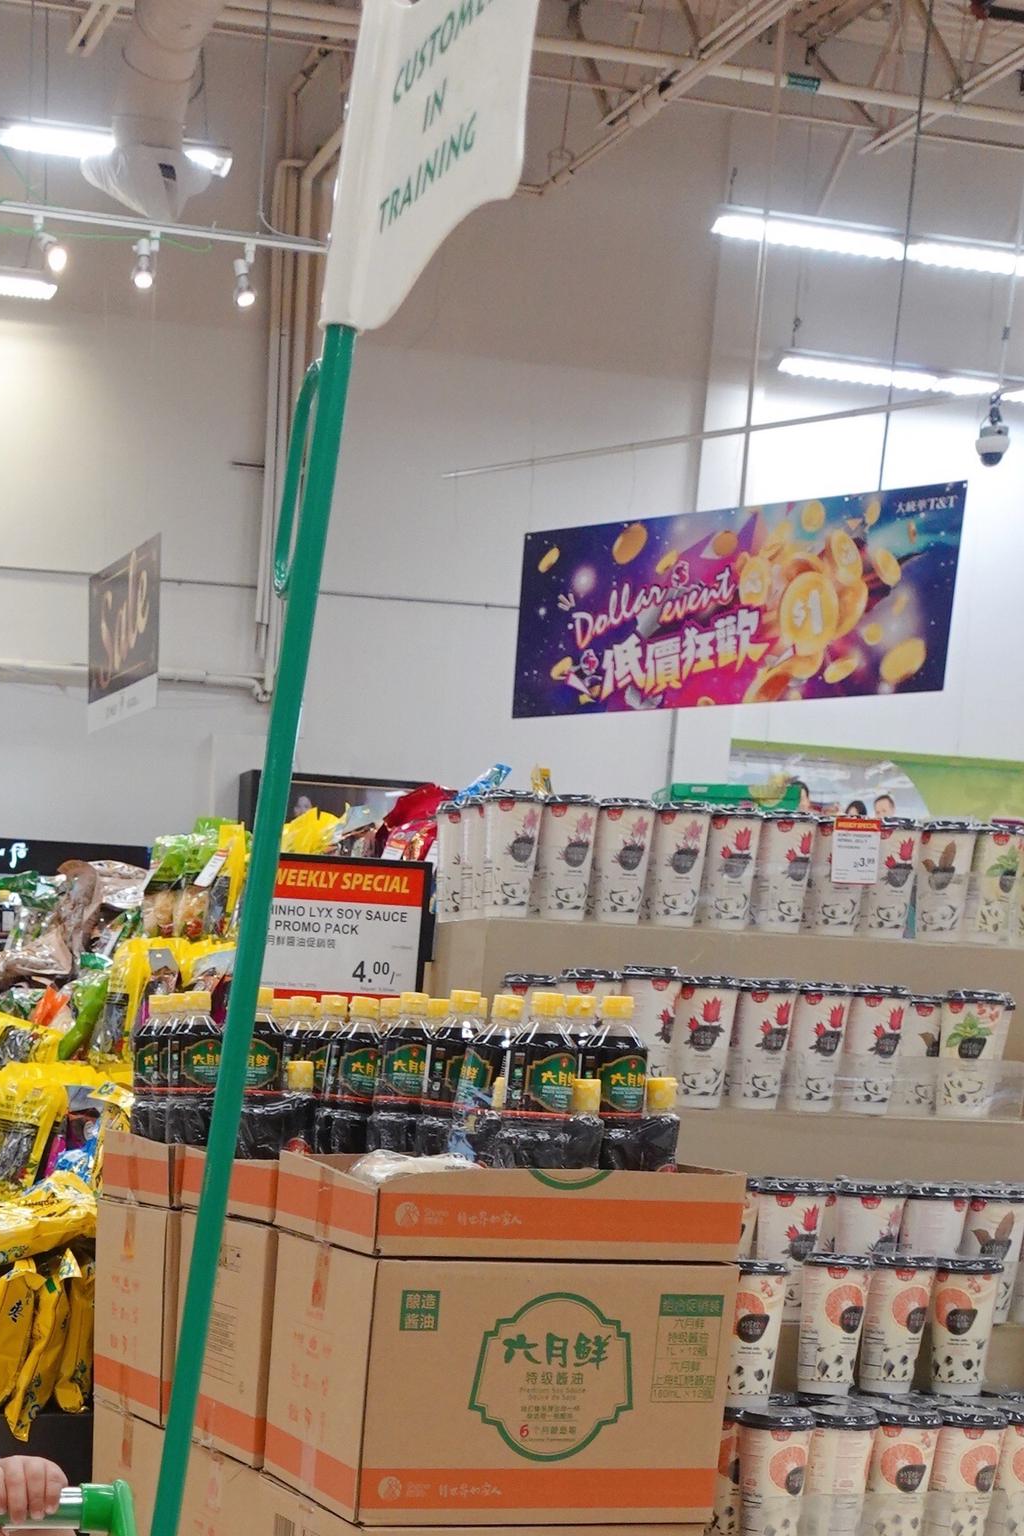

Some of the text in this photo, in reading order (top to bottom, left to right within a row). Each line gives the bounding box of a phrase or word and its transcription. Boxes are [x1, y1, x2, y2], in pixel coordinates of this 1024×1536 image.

[422, 77, 448, 134] IN
[379, 111, 477, 234] TRAINING
[573, 566, 738, 650] Dollar event
[601, 606, 770, 700] 低價狂歡
[340, 872, 410, 894] SPECIAL
[274, 919, 360, 935] PROMO PACK
[309, 907, 334, 919] LYX
[336, 908, 362, 921] SOY
[365, 909, 409, 923] SAUCE
[502, 1331, 613, 1370] 六月鲜
